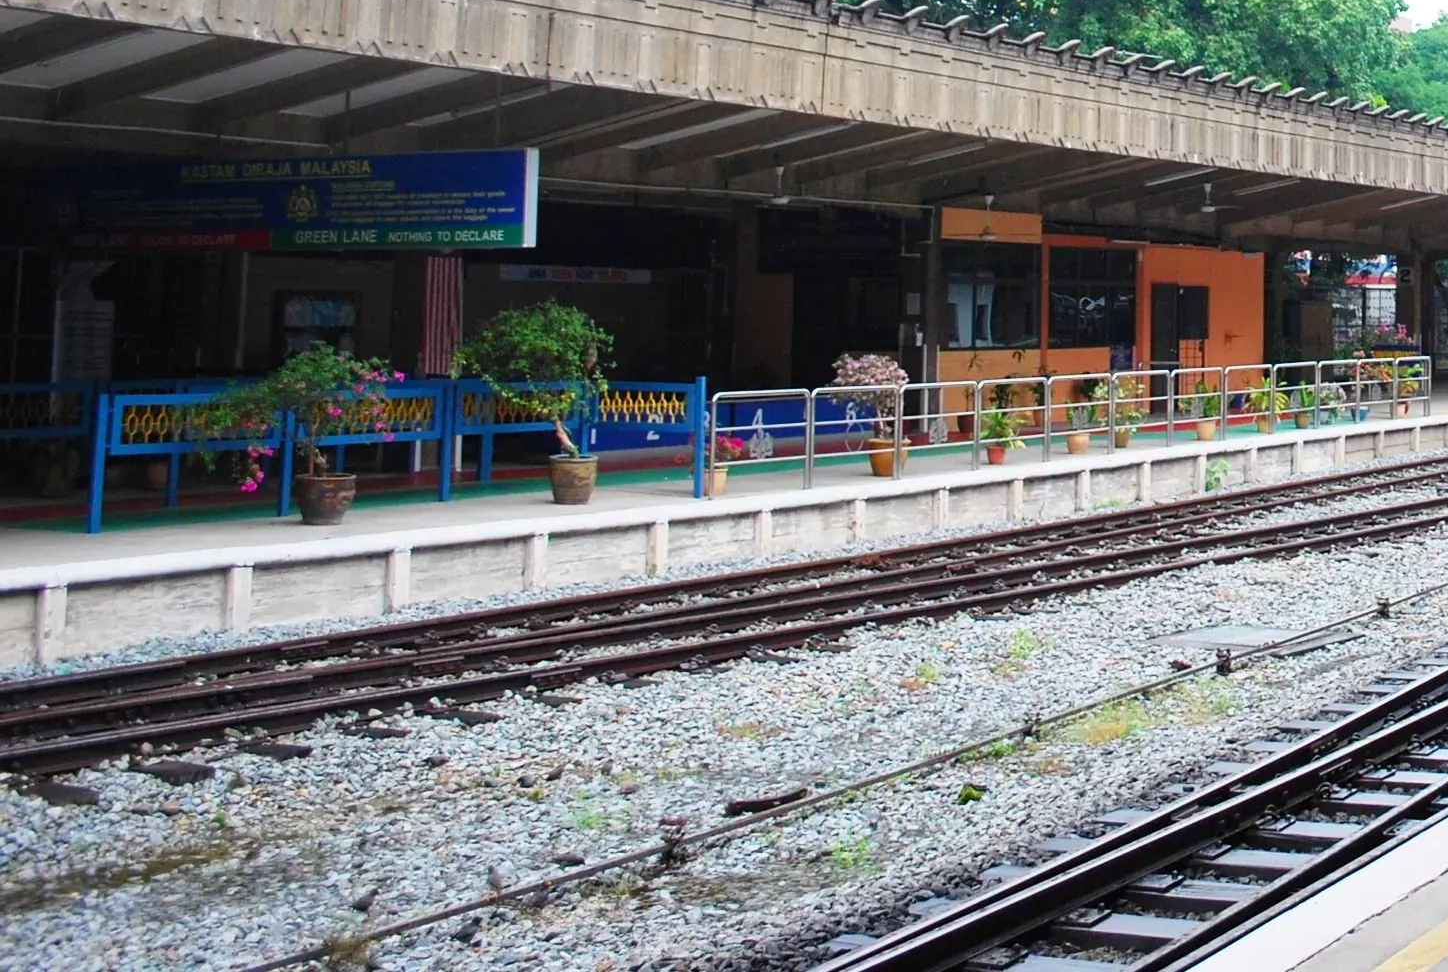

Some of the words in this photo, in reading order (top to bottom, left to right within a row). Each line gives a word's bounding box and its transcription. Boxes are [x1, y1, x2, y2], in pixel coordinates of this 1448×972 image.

[181, 164, 235, 180] KASTAM
[243, 161, 292, 177] DIRAJA
[300, 159, 371, 176] MALAYSIA
[295, 229, 338, 244] GREEN
[343, 228, 378, 243] LANE
[388, 230, 432, 243] NOTHING
[437, 230, 451, 242] TO
[454, 229, 505, 242] DECLARE
[1399, 269, 1411, 283] 2
[751, 408, 765, 432] 4
